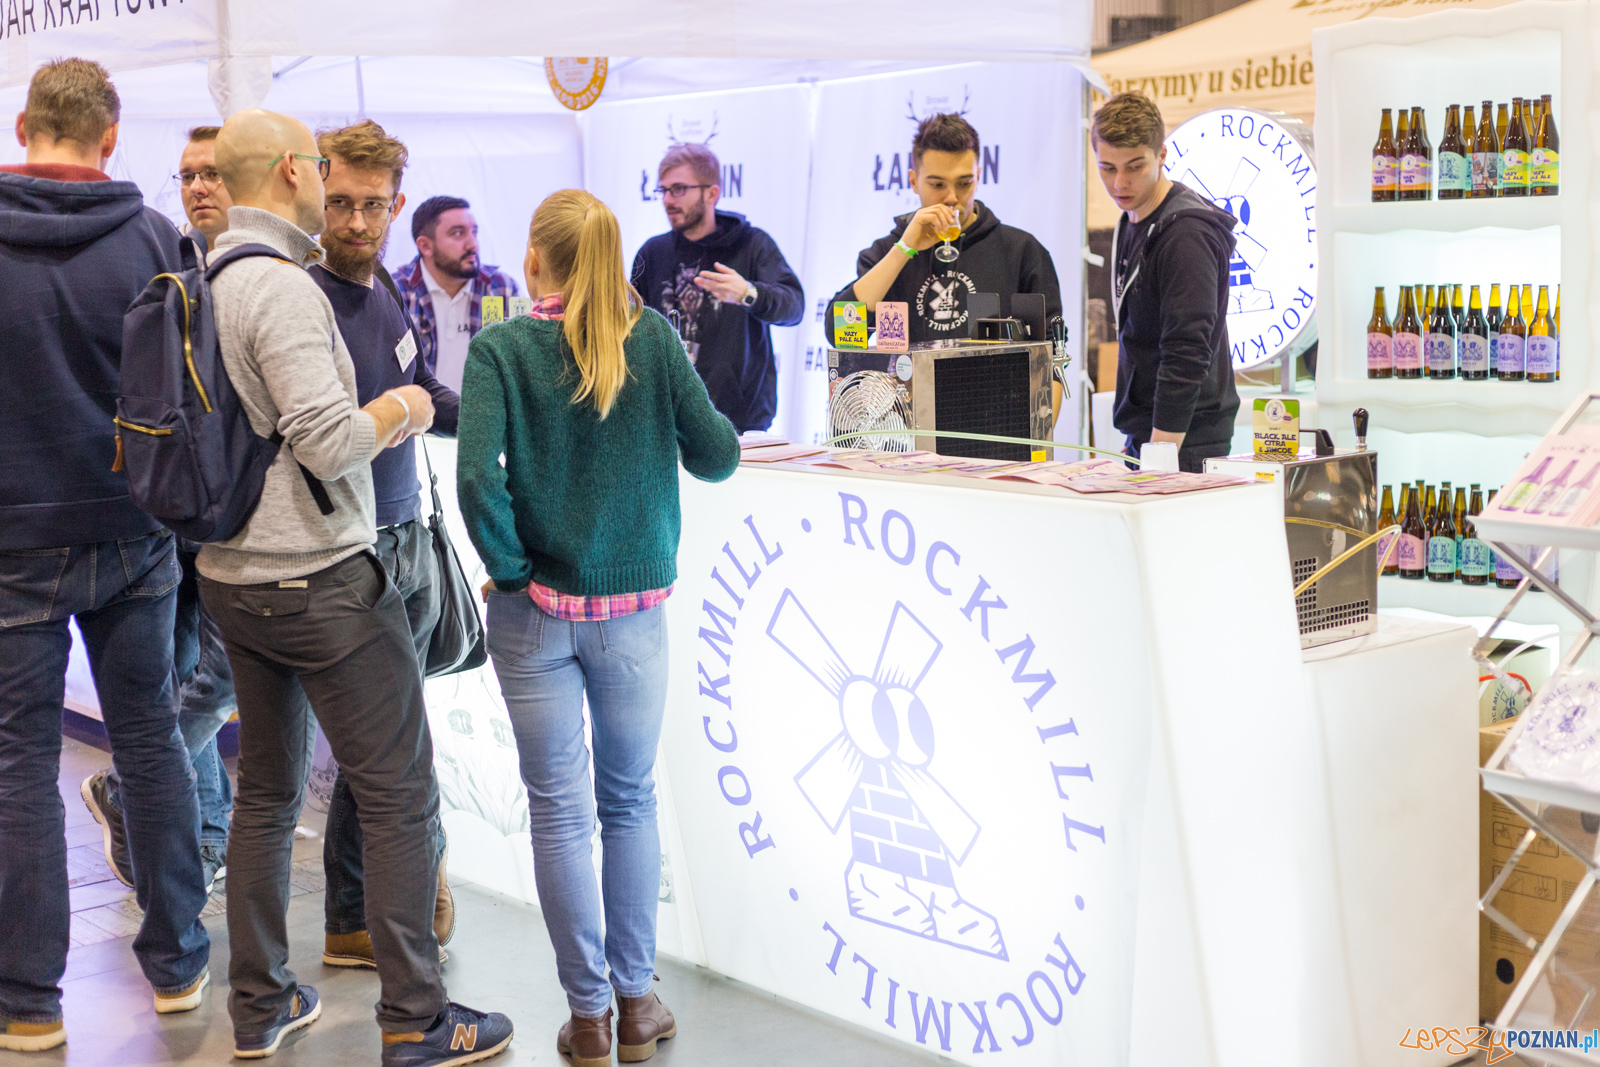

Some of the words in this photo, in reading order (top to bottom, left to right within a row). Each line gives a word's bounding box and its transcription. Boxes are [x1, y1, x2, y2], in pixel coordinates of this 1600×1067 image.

[1208, 70, 1225, 94] u
[1254, 432, 1280, 440] BLACK
[1281, 433, 1297, 441] ALE
[697, 513, 785, 859] ROCKMILL
[838, 491, 1106, 852] ROCKMILL
[822, 920, 1088, 1054] ROCKMILL
[450, 1023, 478, 1051] N
